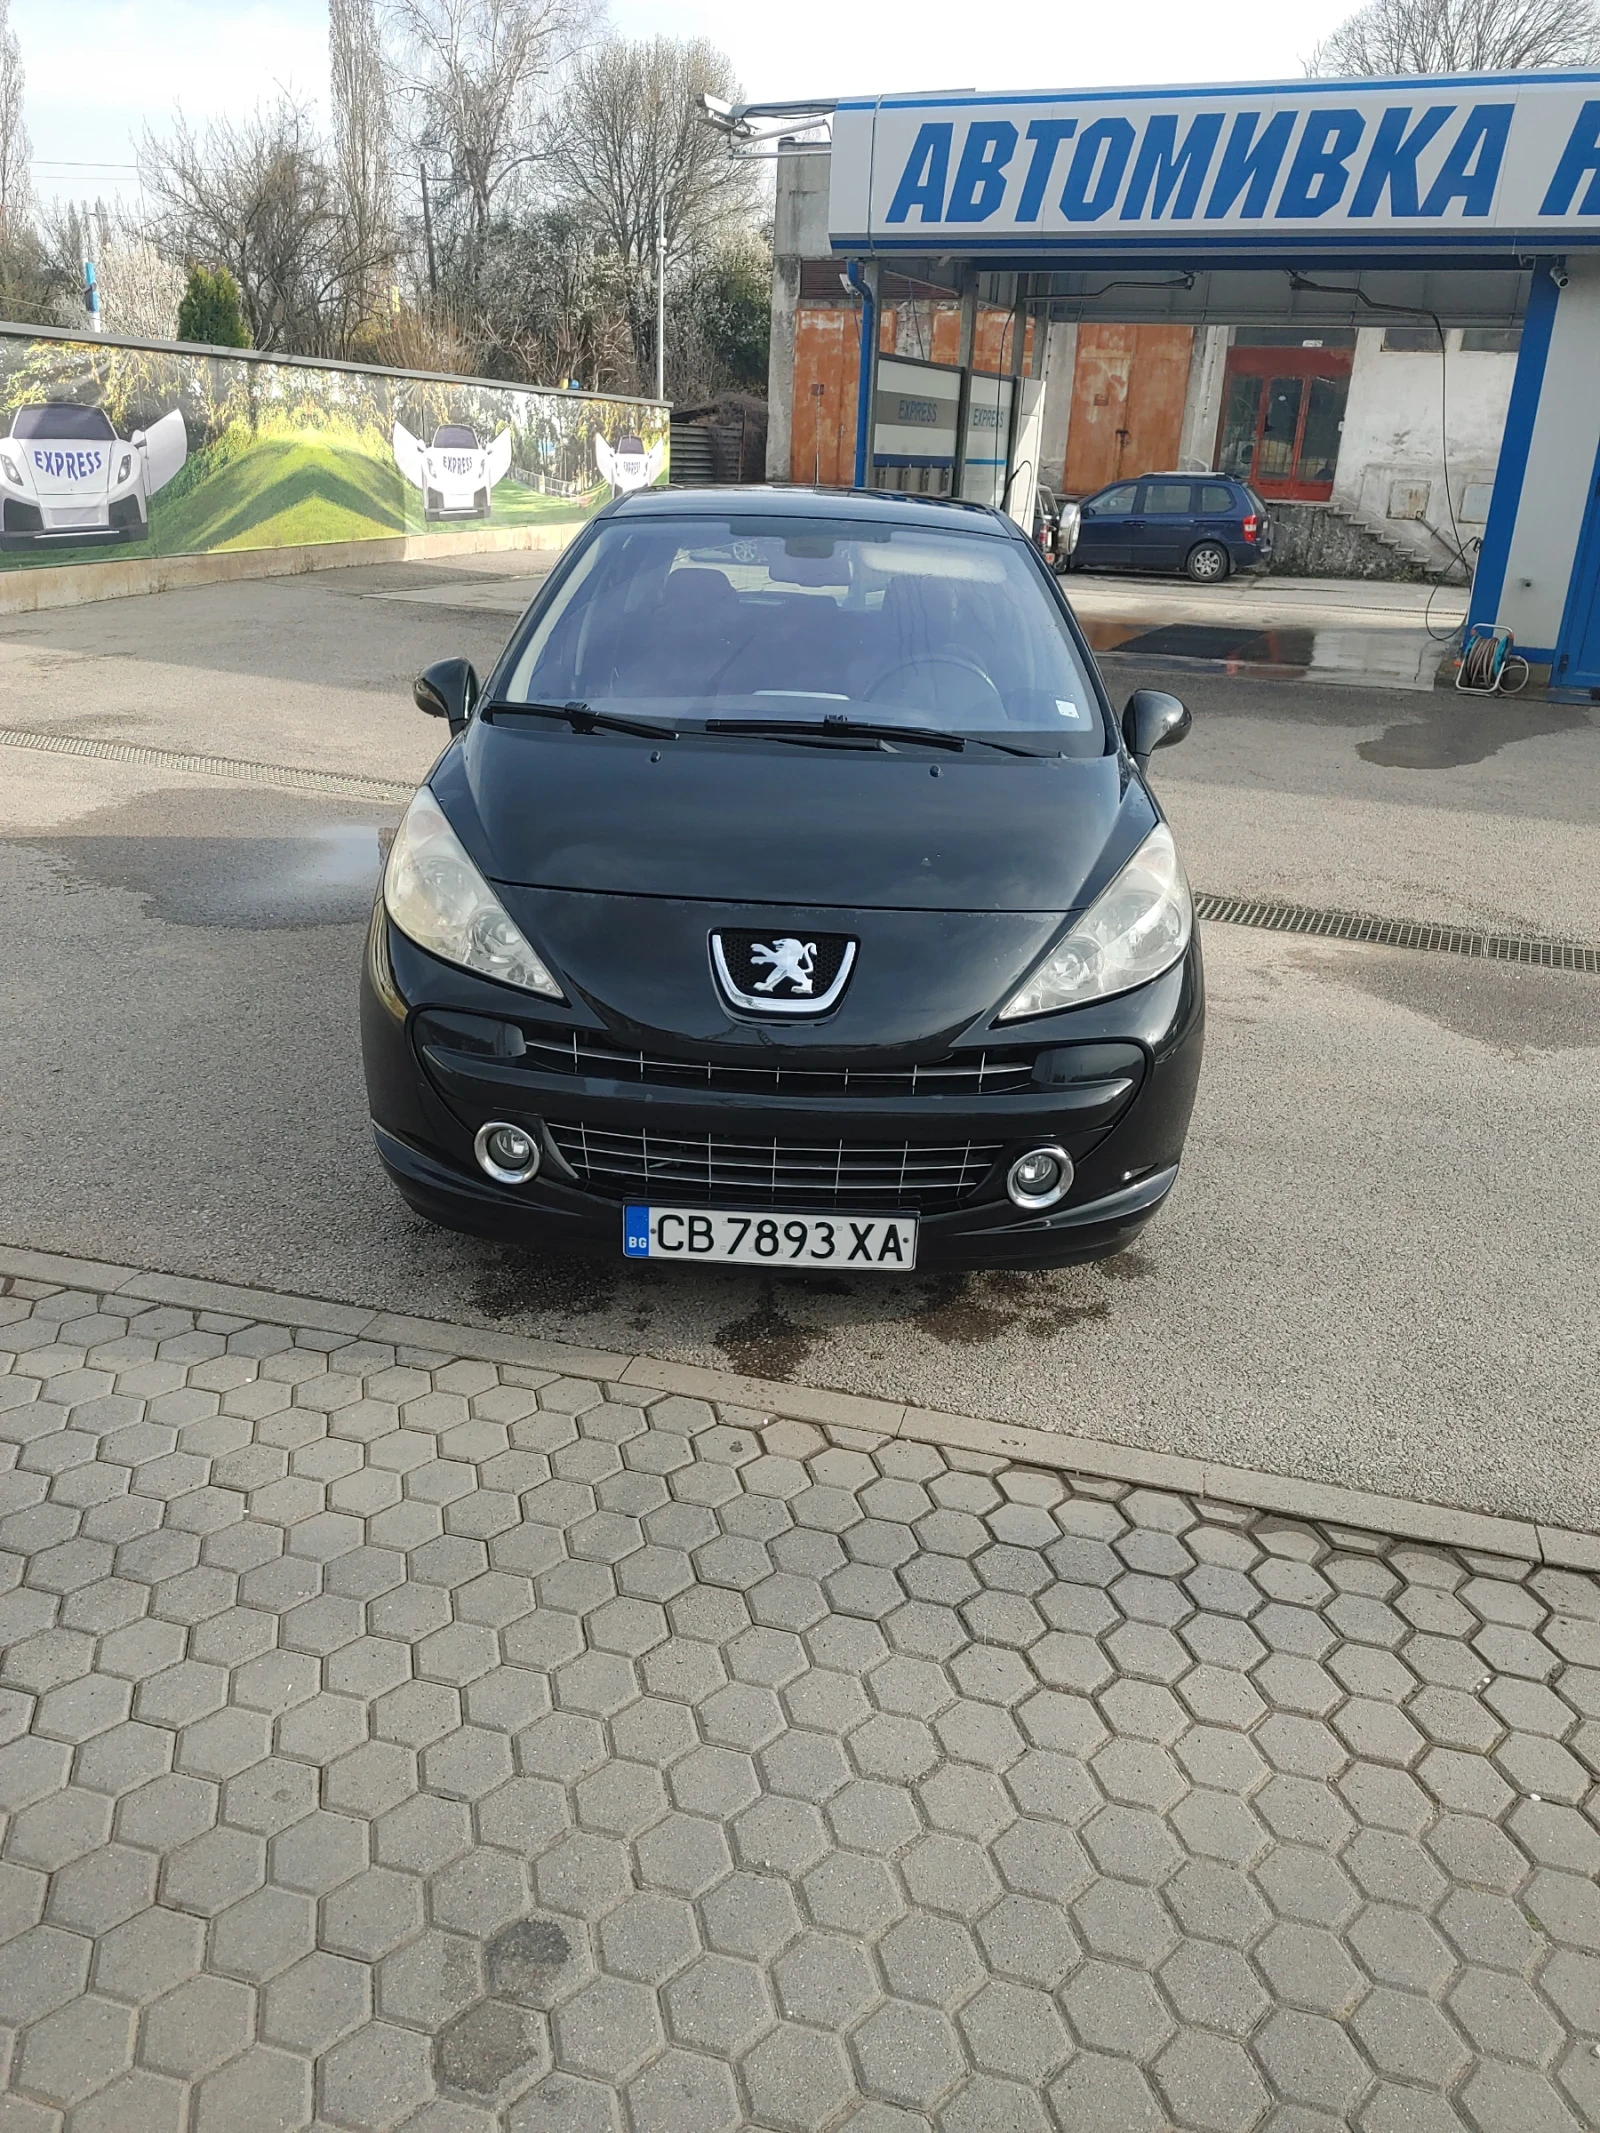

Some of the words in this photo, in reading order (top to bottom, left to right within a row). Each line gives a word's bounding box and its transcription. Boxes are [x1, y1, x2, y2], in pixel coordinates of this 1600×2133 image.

[885, 104, 1515, 223] АВТОМИВКА
[898, 400, 938, 423] EXPRESS
[973, 408, 1004, 428] EXPRES
[34, 450, 102, 481] EXPRESS
[443, 456, 472, 475] EXPRESS
[628, 1236, 647, 1249] BG
[727, 1217, 836, 1259] 7893
